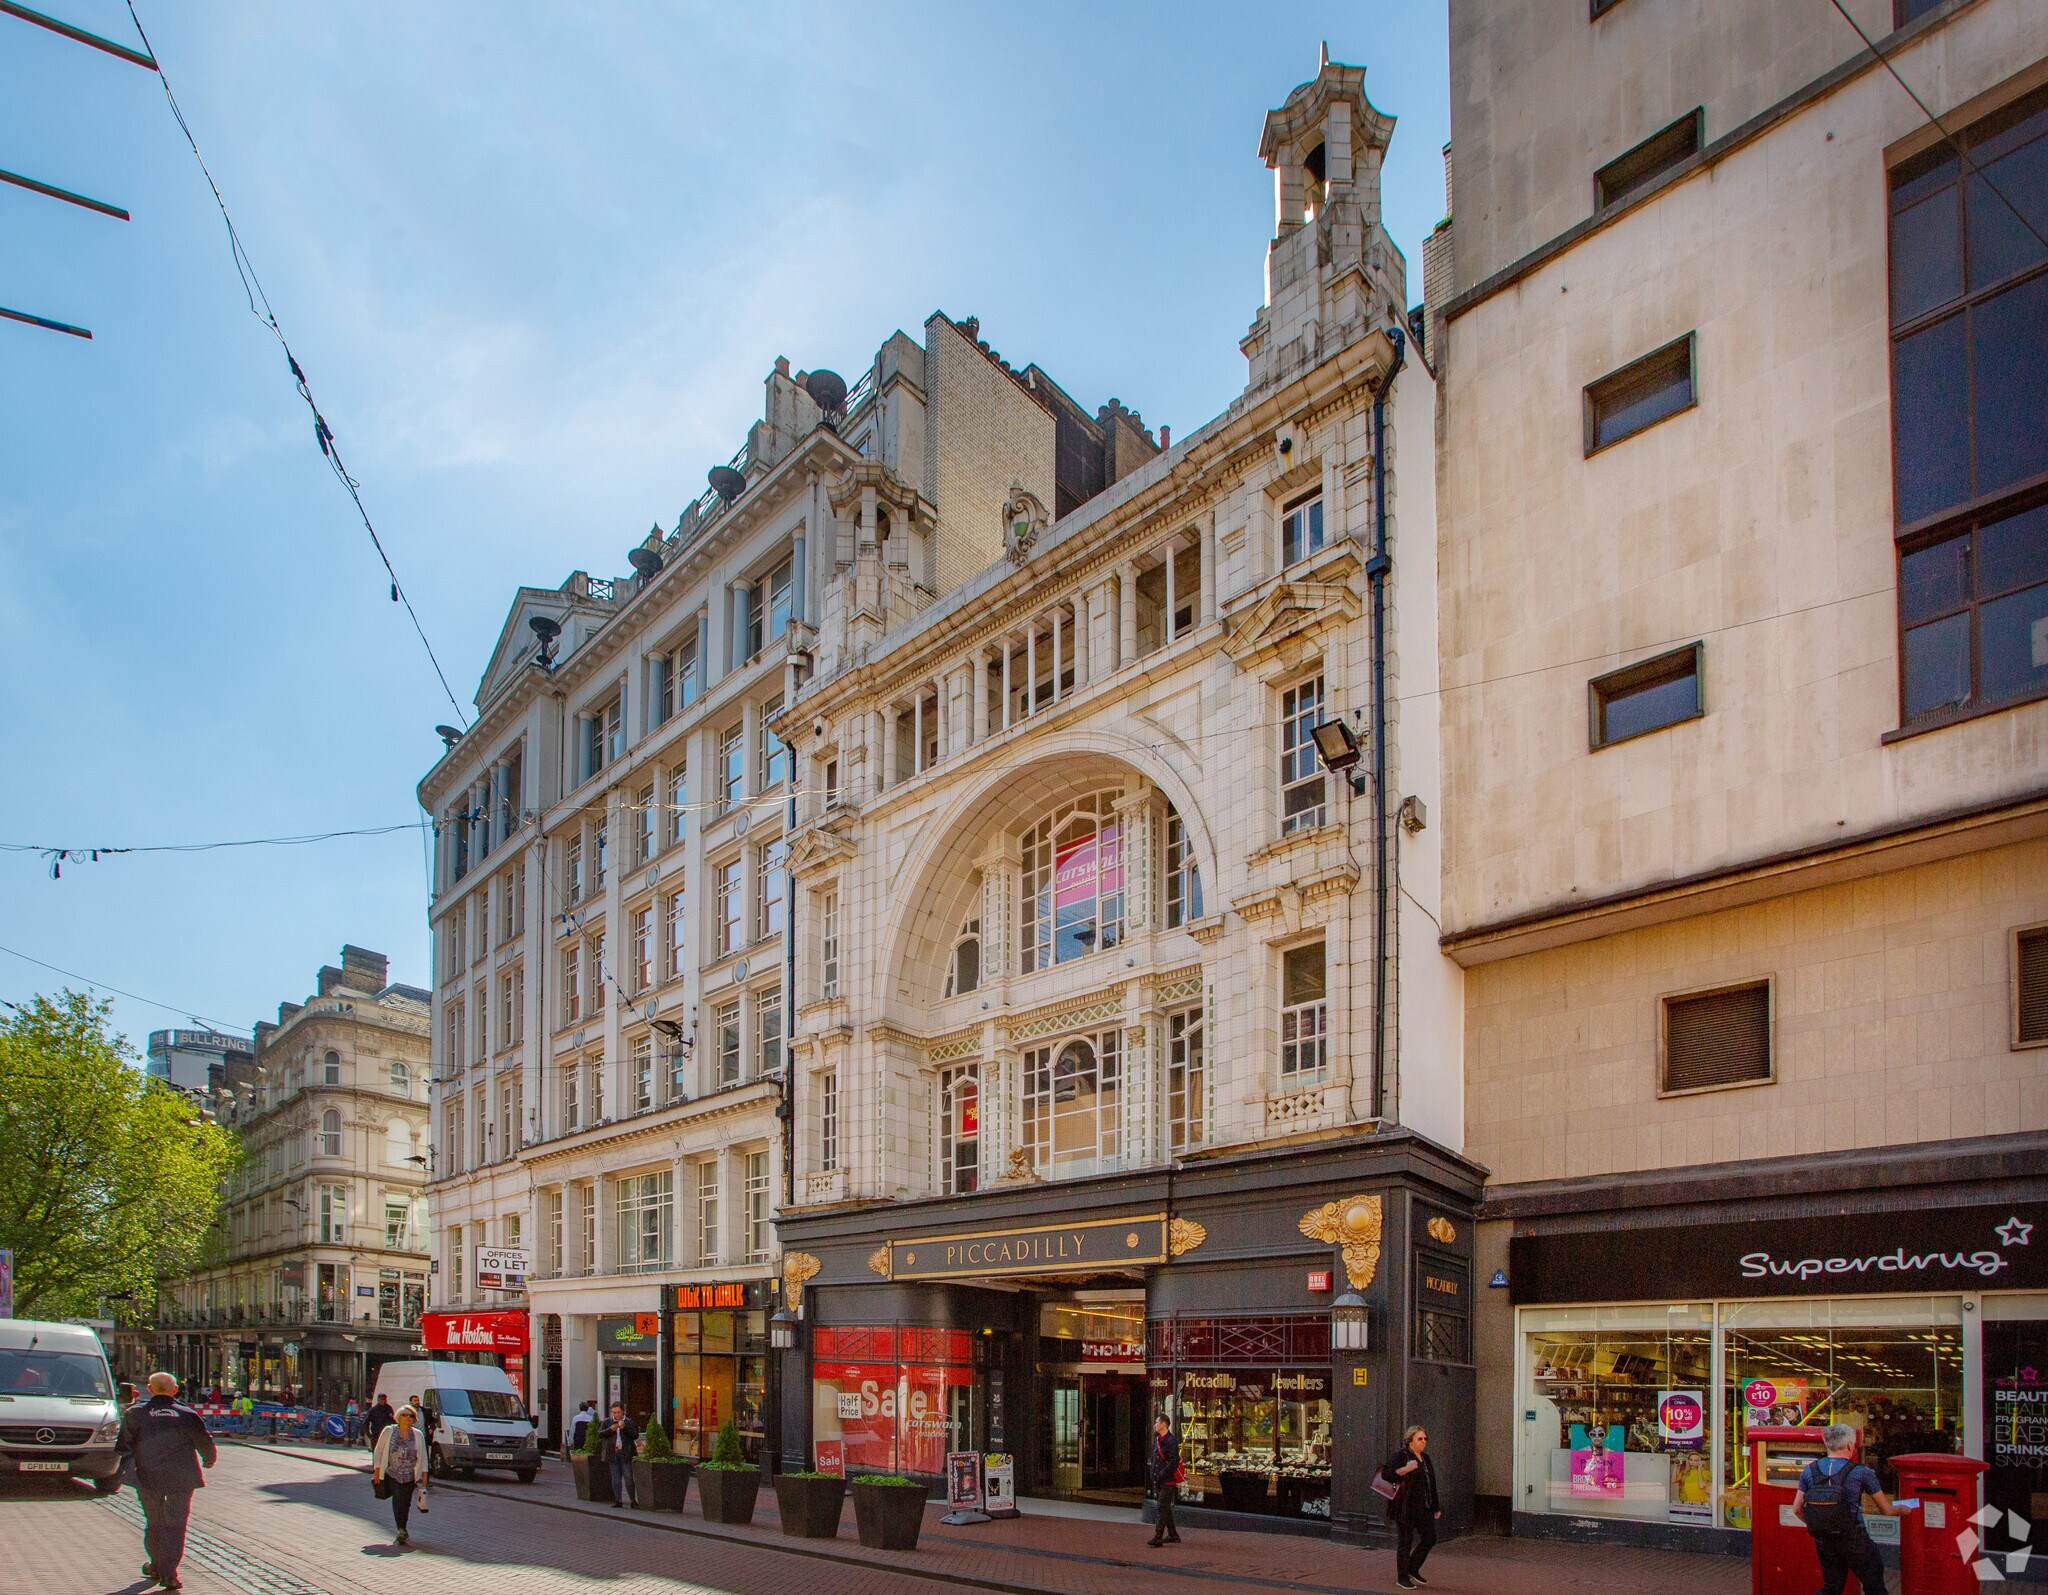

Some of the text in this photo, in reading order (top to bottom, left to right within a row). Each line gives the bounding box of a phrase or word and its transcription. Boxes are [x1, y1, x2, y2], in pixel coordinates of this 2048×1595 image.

[180, 1033, 247, 1051] BULLRING
[487, 1250, 523, 1259] OFFICES
[947, 1234, 1086, 1265] PICCADILLY
[481, 1258, 528, 1271] TO LET
[1739, 1248, 2008, 1280] Superdrug
[1426, 1276, 1457, 1295] PICCADILLY
[677, 1284, 744, 1308] WOK TO WALK
[445, 1318, 494, 1345] Tim Hortons
[1185, 1371, 1324, 1391] Piccadilly Jewellers
[1355, 1371, 1365, 1383] H
[840, 1394, 859, 1407] Half
[861, 1380, 928, 1420] Sale
[1751, 1390, 1771, 1400] £10
[840, 1406, 859, 1416] Price
[1668, 1408, 1693, 1420] 10%
[906, 1420, 962, 1430] COTSWOLD
[819, 1456, 841, 1466] Sale
